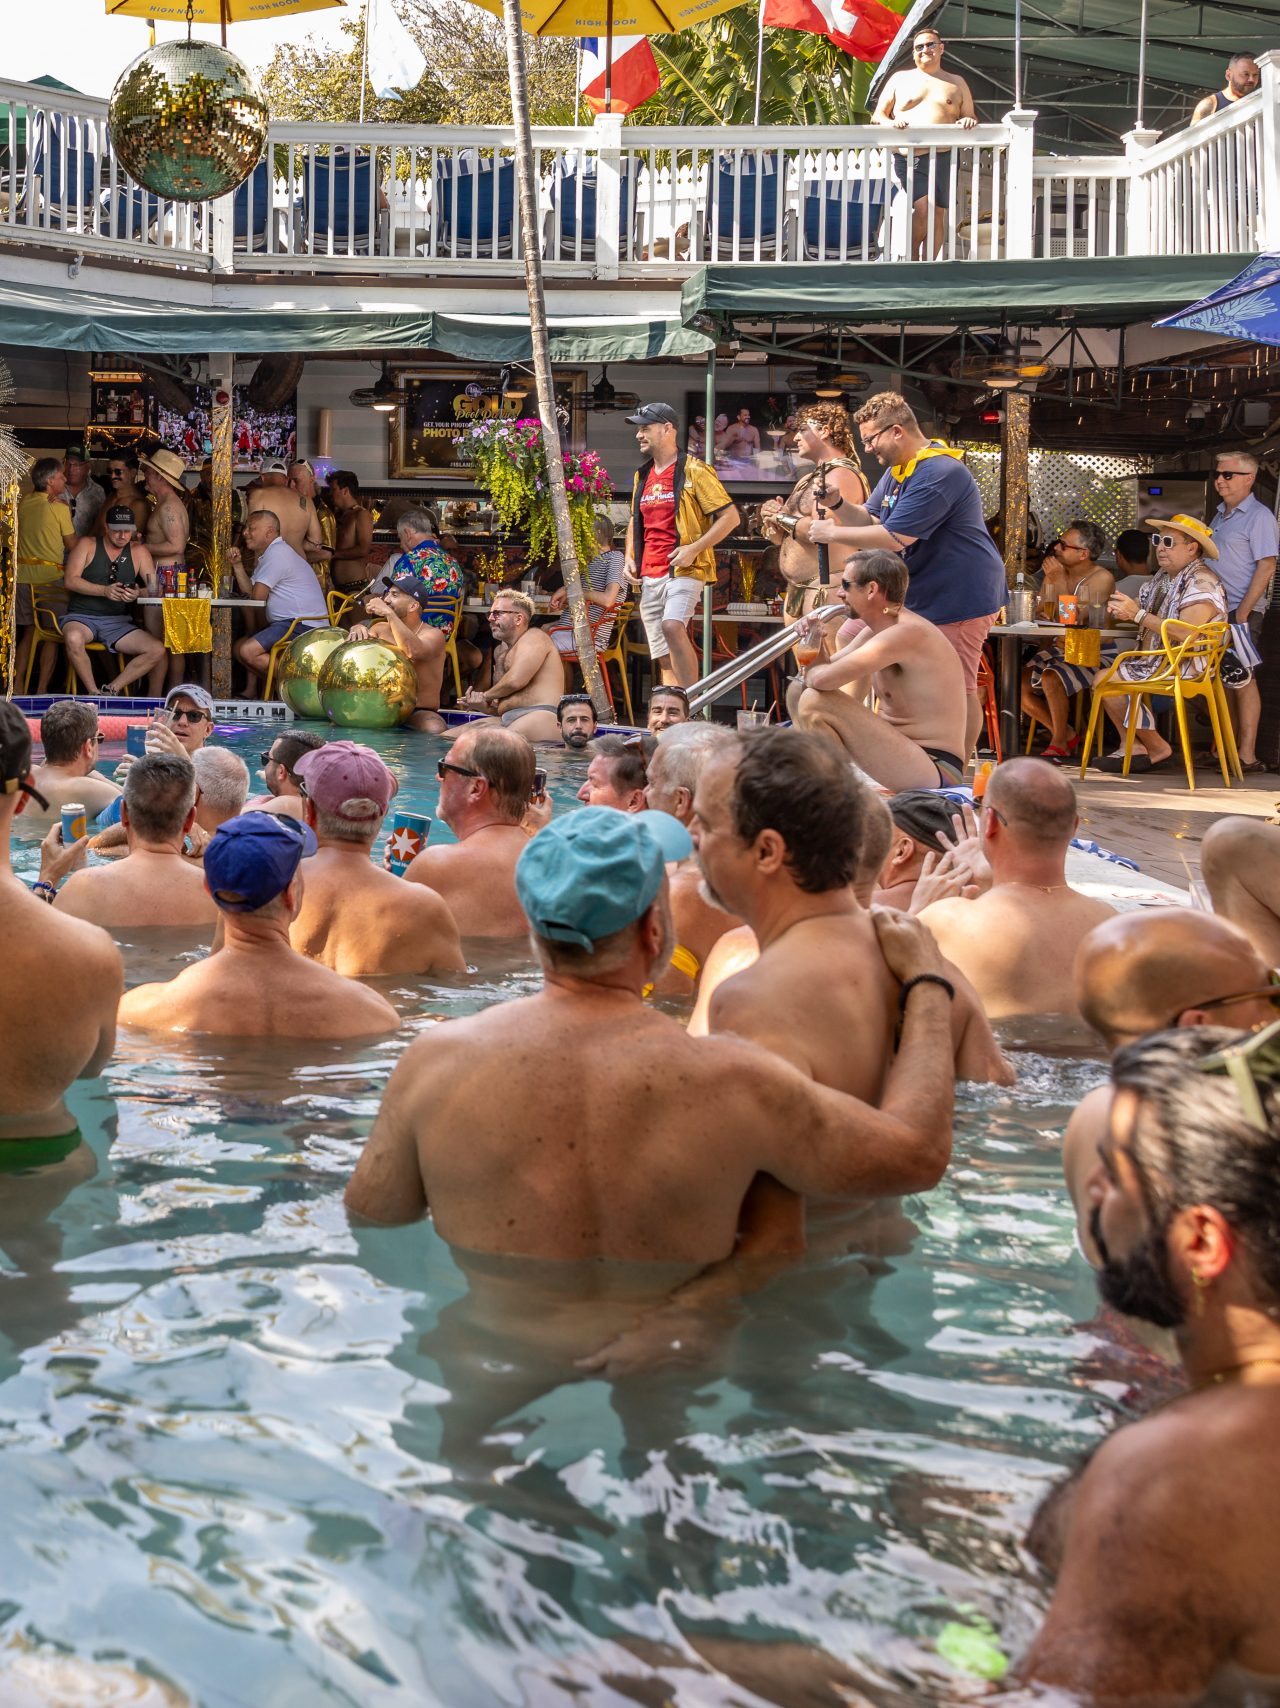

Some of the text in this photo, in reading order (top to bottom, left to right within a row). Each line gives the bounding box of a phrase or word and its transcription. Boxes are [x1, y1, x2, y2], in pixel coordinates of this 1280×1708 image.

[149, 5, 175, 13] HIGH
[249, 3, 271, 11] HIGH
[520, 8, 535, 20] OON
[453, 394, 523, 414] GOLD
[455, 409, 480, 421] Pool
[423, 428, 461, 438] PHOTO
